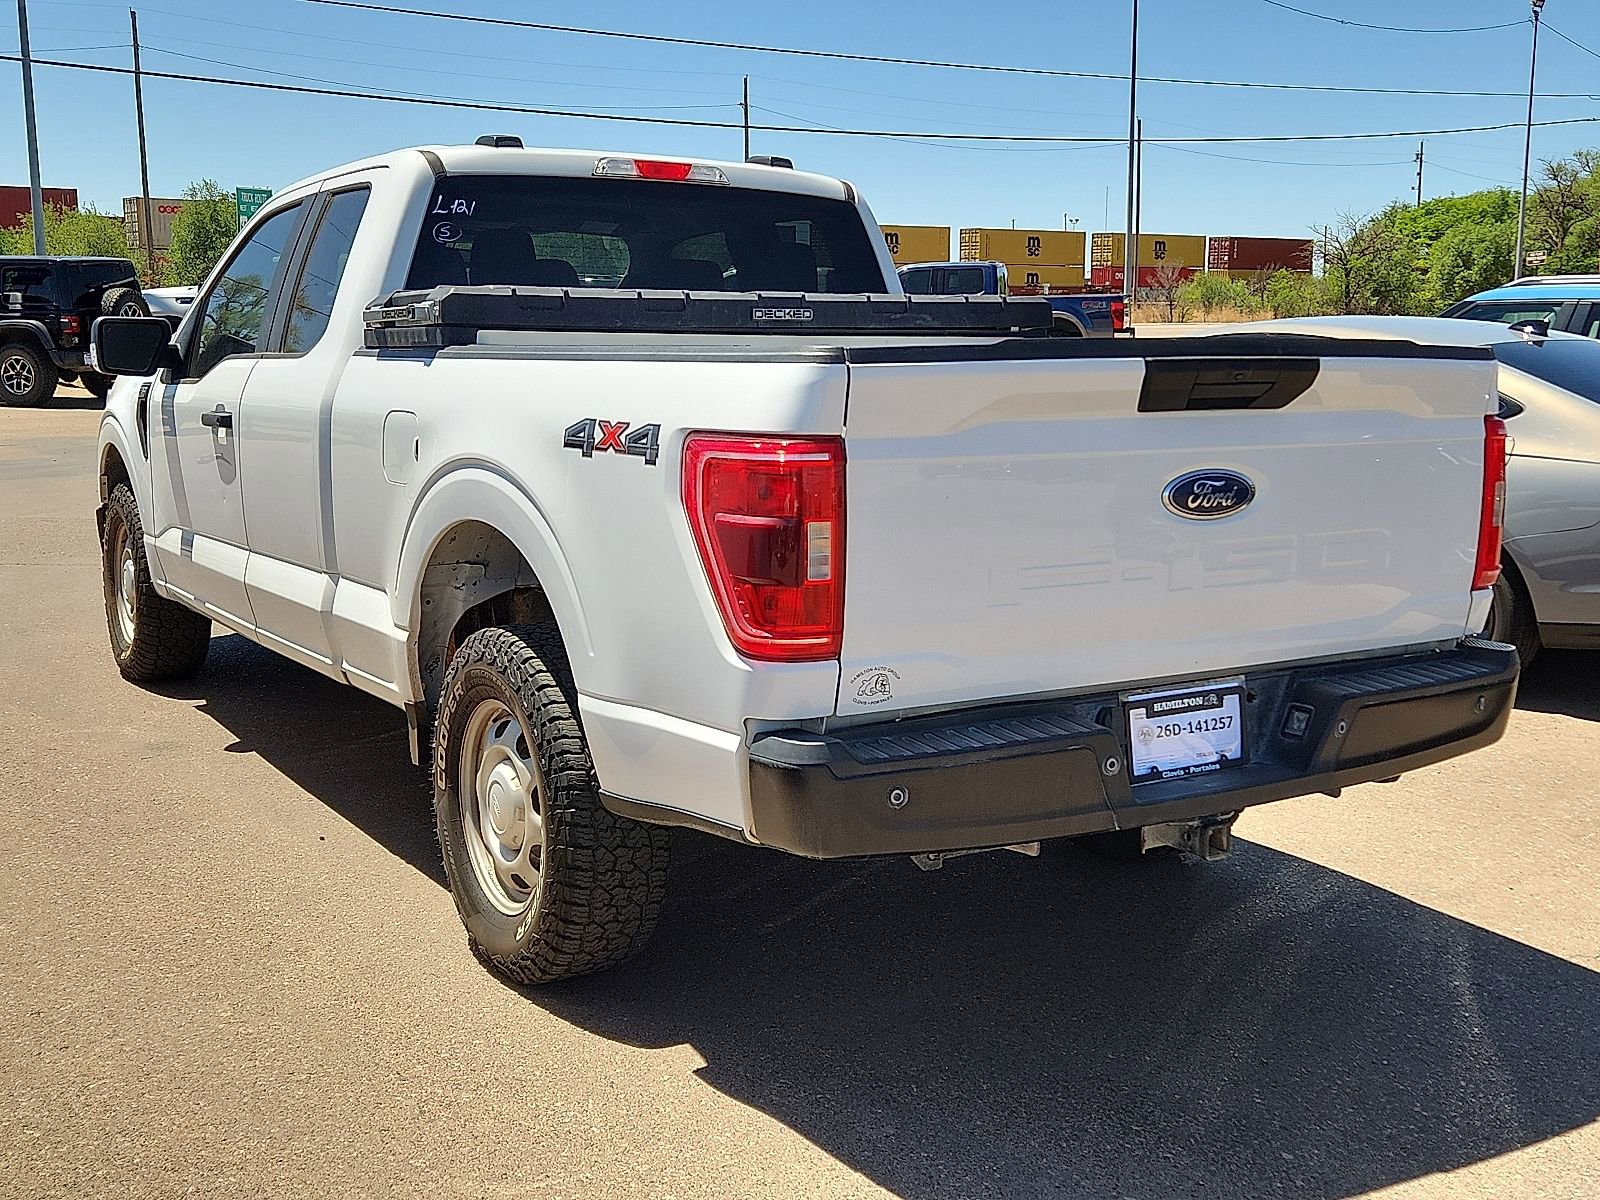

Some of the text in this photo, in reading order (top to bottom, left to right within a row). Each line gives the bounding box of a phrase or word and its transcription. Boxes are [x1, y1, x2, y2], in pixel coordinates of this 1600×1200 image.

[158, 205, 183, 213] OOC
[754, 309, 811, 319] DECKED
[1187, 480, 1237, 509] Ford
[850, 668, 873, 684] HAMILTON
[887, 668, 901, 680] GROUP
[1153, 696, 1204, 712] HAMILTON
[1156, 716, 1233, 739] 26D-141257
[437, 681, 465, 791] COOPER
[1162, 763, 1220, 778] Clovis Portales
